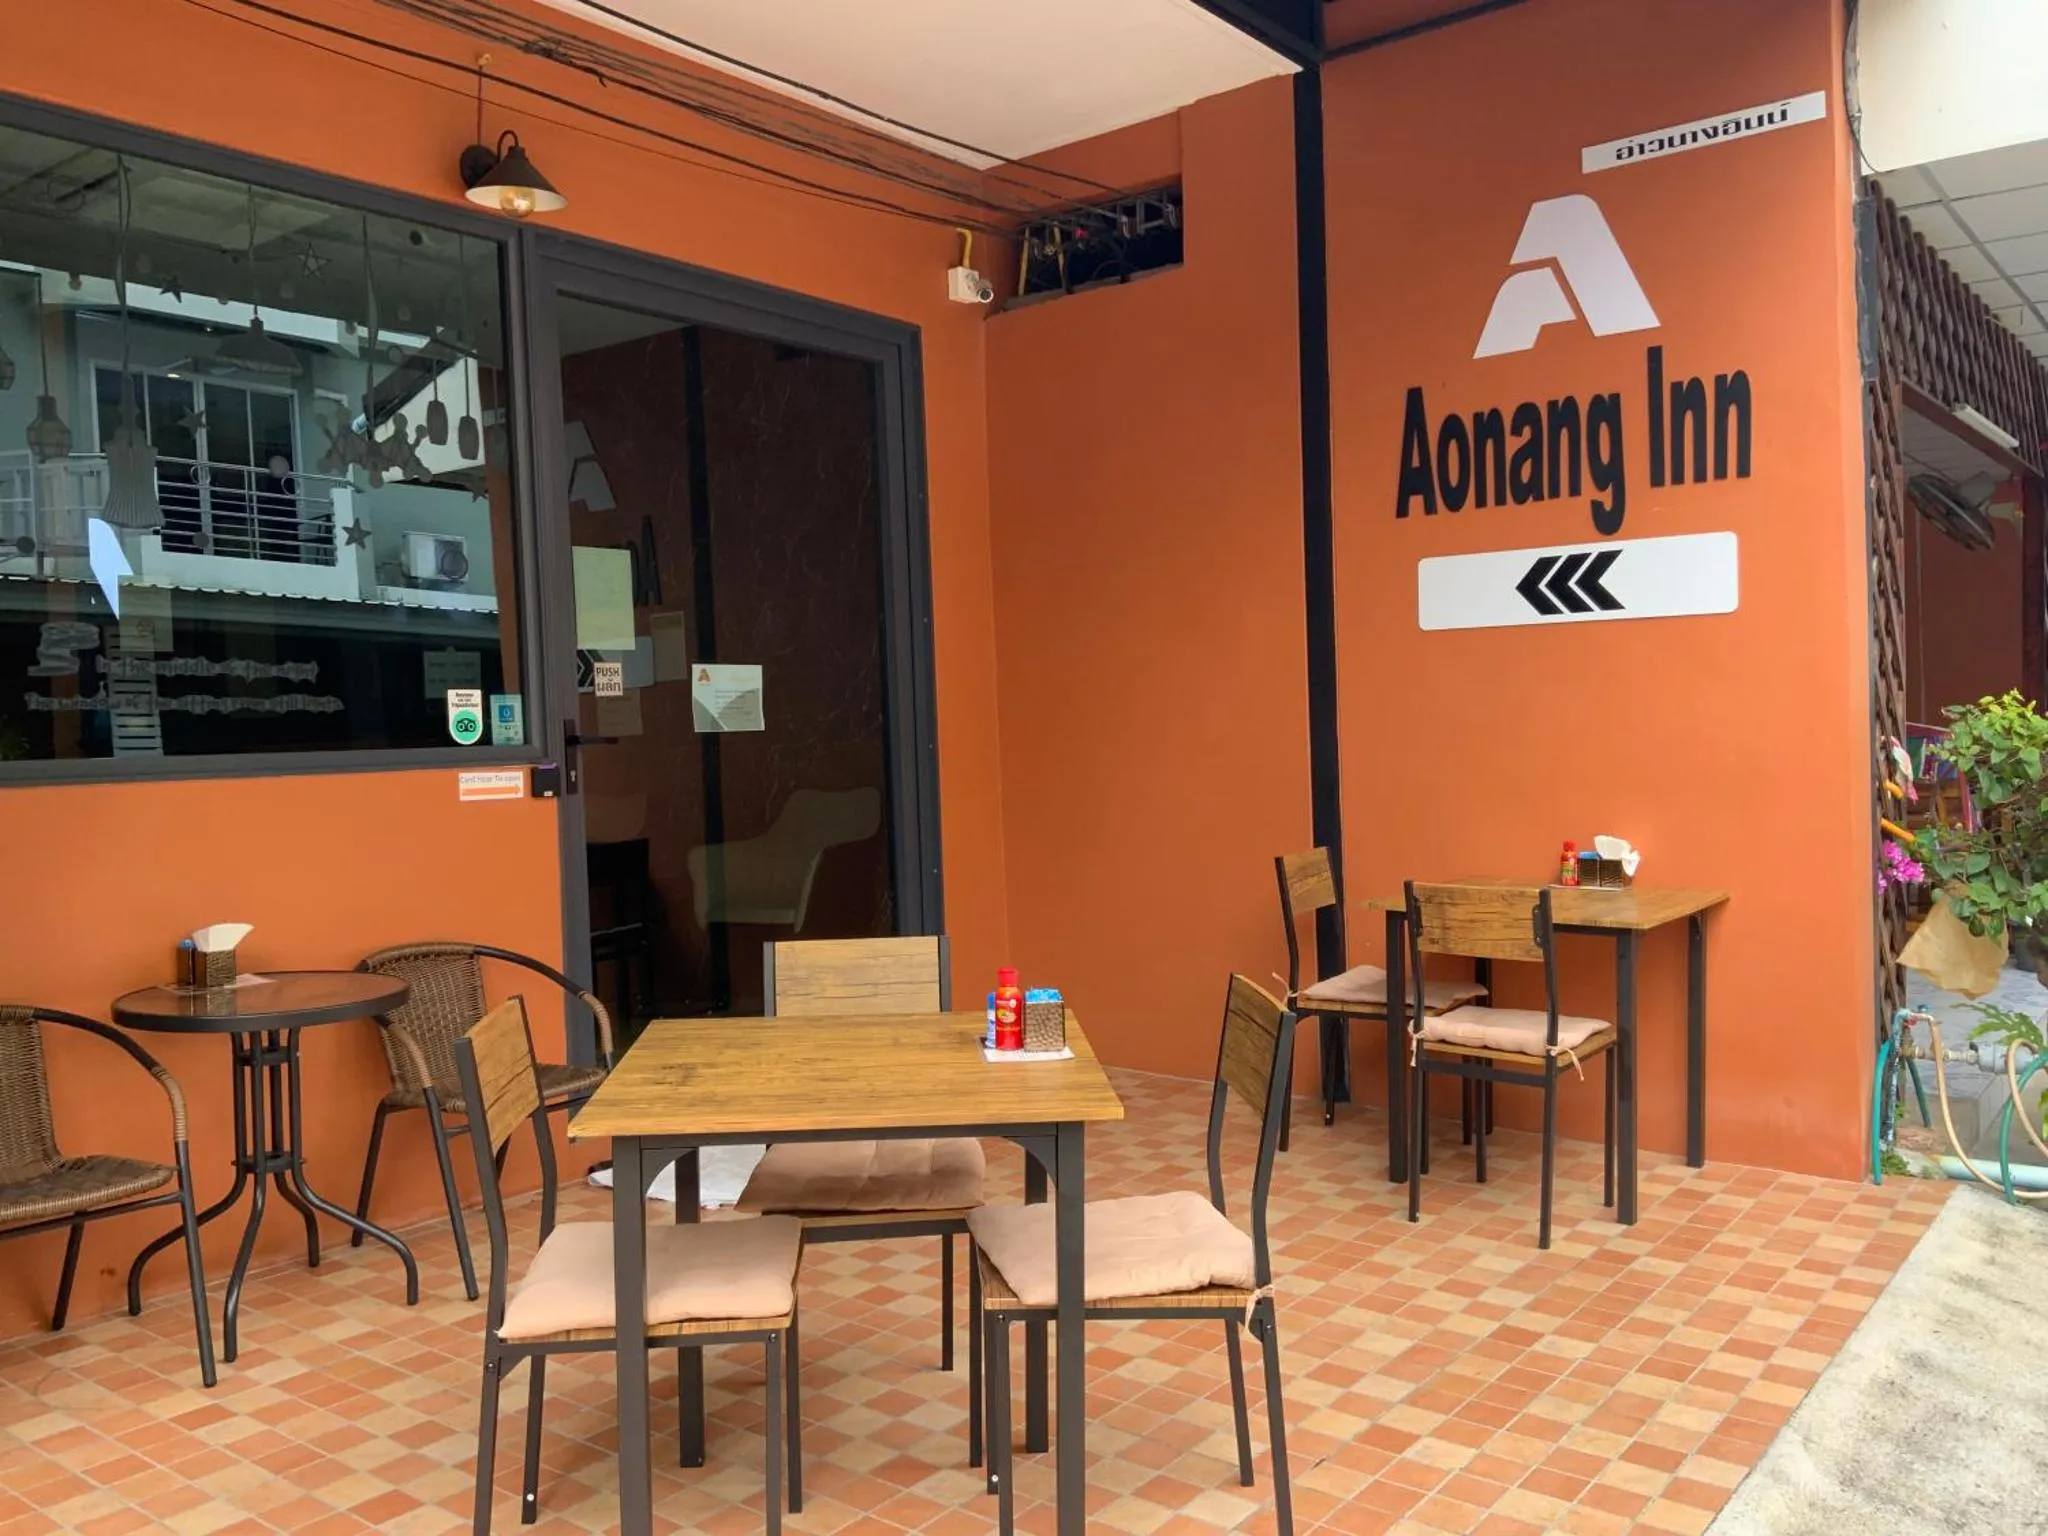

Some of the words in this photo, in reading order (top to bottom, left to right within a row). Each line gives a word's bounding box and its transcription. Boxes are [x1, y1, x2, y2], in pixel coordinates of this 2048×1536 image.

[1395, 386, 1626, 536] Aonang
[1646, 344, 1752, 489] Inn
[596, 667, 619, 677] PUSH
